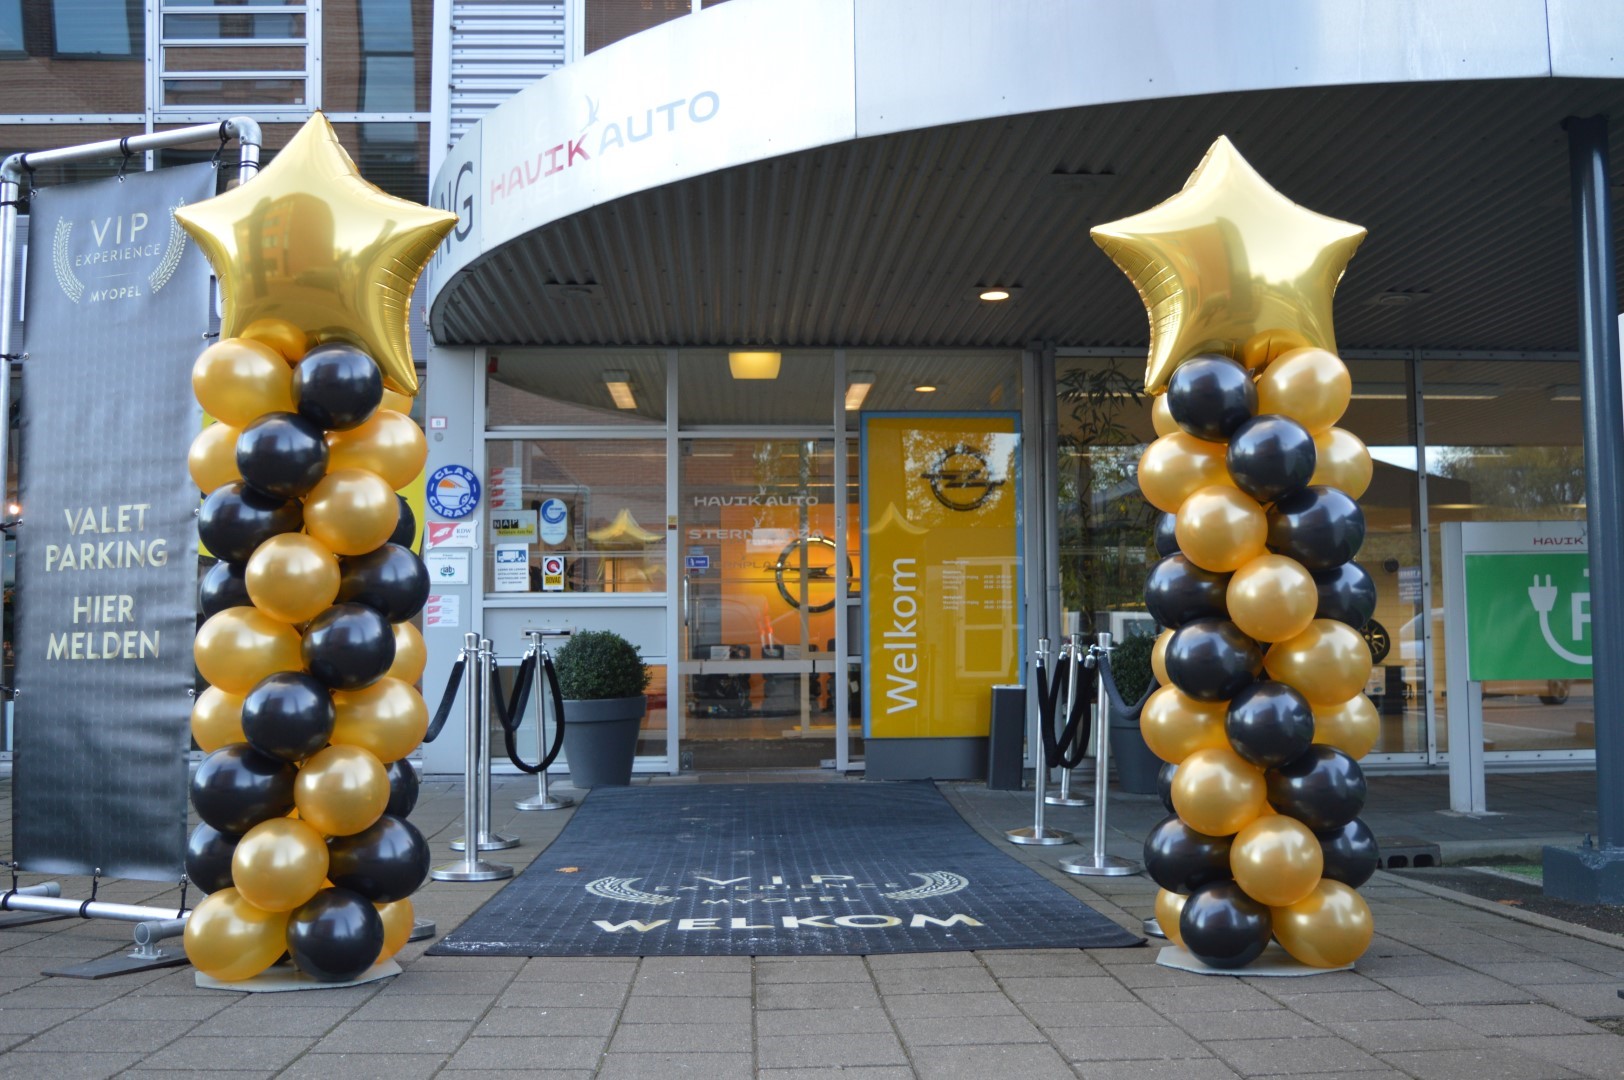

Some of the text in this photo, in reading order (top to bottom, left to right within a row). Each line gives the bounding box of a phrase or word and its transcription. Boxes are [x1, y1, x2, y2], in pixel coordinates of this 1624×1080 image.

[490, 90, 720, 205] HAVIK AUTO
[91, 212, 149, 248] VIP
[75, 243, 161, 267] EXPERIENCE
[89, 286, 142, 303] MYOPEL
[434, 467, 474, 482] GLAS
[428, 495, 477, 519] GARANT
[694, 495, 819, 507] HAVIK AUTO
[64, 503, 151, 536] VALET
[1532, 536, 1584, 546] HAVIK
[45, 538, 168, 572] PARKING
[545, 576, 561, 584] BOVAG
[73, 594, 134, 624] HIER
[46, 630, 160, 661] MELDEN
[883, 557, 918, 715] Welkom
[654, 882, 902, 891] EXPERIENCE
[694, 874, 855, 886] VIP
[701, 896, 862, 905] MYOPEL
[592, 913, 986, 932] WELKOM
